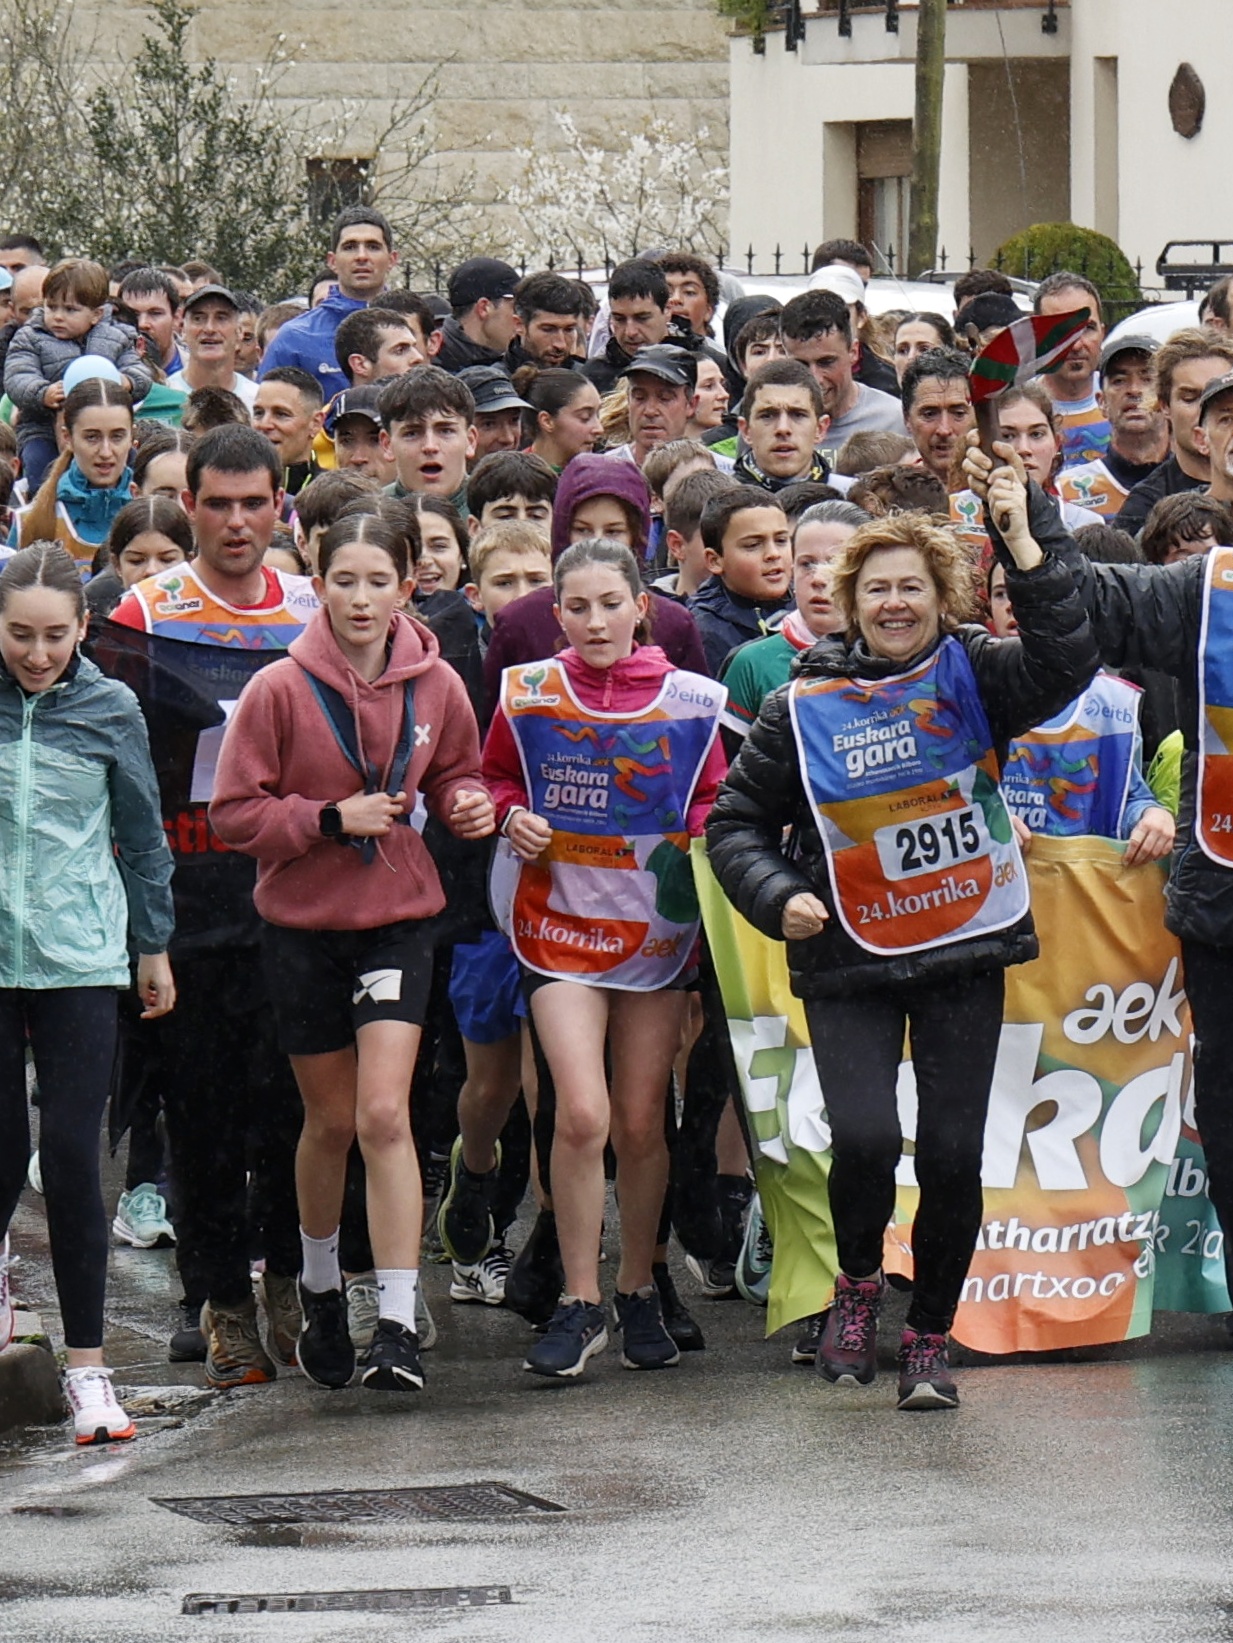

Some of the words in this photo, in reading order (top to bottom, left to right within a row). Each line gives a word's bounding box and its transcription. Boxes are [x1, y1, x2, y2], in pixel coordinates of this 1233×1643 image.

[294, 594, 319, 609] eit
[678, 687, 714, 709] eitb
[1101, 704, 1133, 724] eitb
[832, 719, 911, 753] Euskara
[845, 735, 917, 779] gara
[541, 764, 609, 787] Euskara
[543, 784, 609, 809] gara
[1003, 785, 1045, 806] kara
[566, 843, 613, 857] LABORAL
[896, 811, 980, 872] 2915
[994, 851, 1019, 888] aek
[857, 876, 981, 925] 24.korrika
[518, 916, 624, 955] 24.korrika
[1063, 956, 1188, 1045] aek
